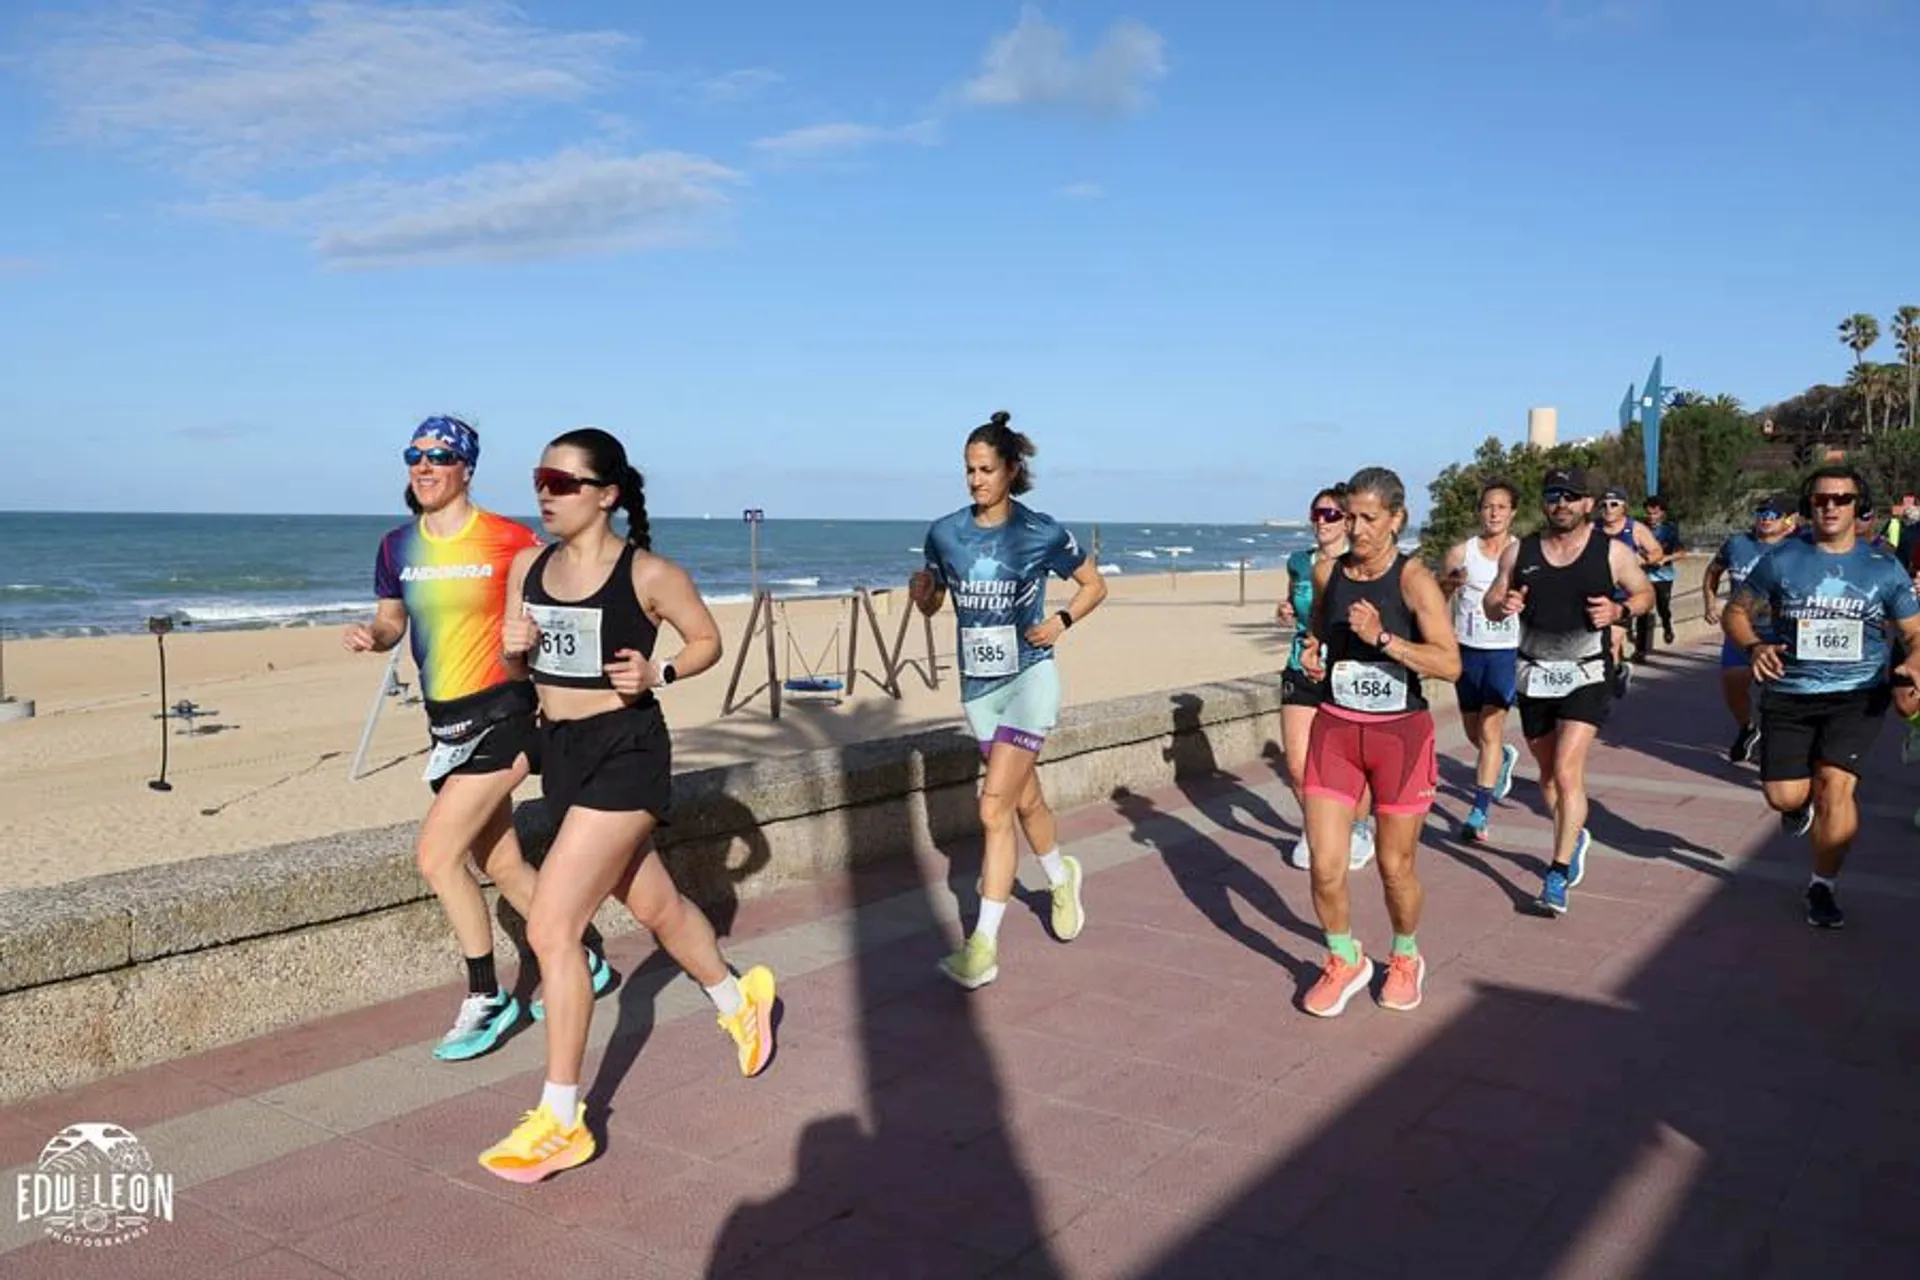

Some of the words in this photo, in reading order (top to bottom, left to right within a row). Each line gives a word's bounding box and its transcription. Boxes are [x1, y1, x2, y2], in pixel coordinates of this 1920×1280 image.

[960, 580, 1017, 595] MEDIA
[1815, 635, 1849, 648] 1662
[972, 645, 1005, 662] 1585
[1351, 680, 1392, 697] 1584
